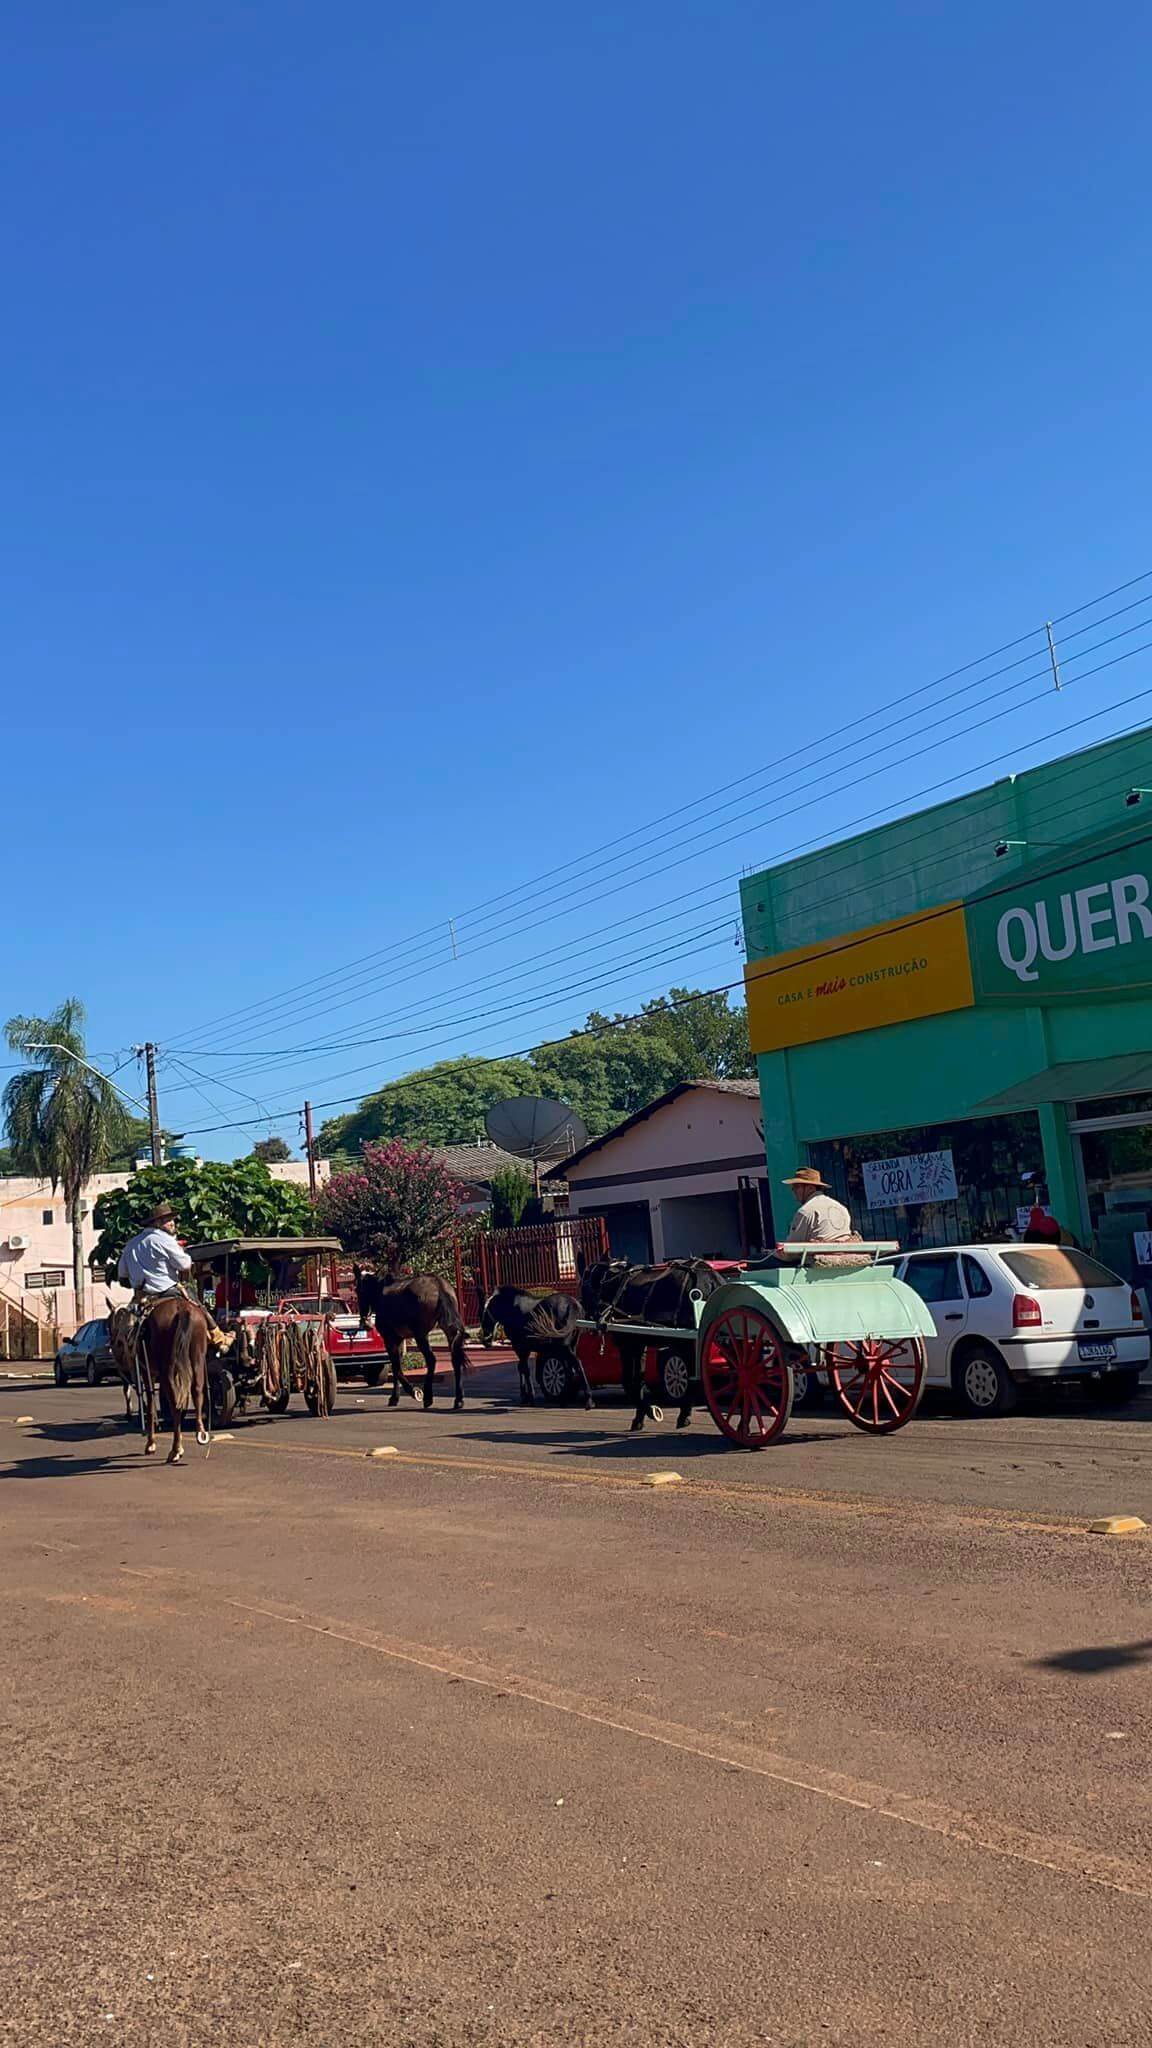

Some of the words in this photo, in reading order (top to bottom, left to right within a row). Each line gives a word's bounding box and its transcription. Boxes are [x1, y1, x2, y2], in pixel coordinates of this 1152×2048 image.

[997, 874, 1152, 982] QUER
[777, 991, 803, 1006] CASA
[815, 975, 848, 998] mais
[849, 957, 928, 987] CONSTRUÇÃO
[881, 1169, 914, 1195] OBRA
